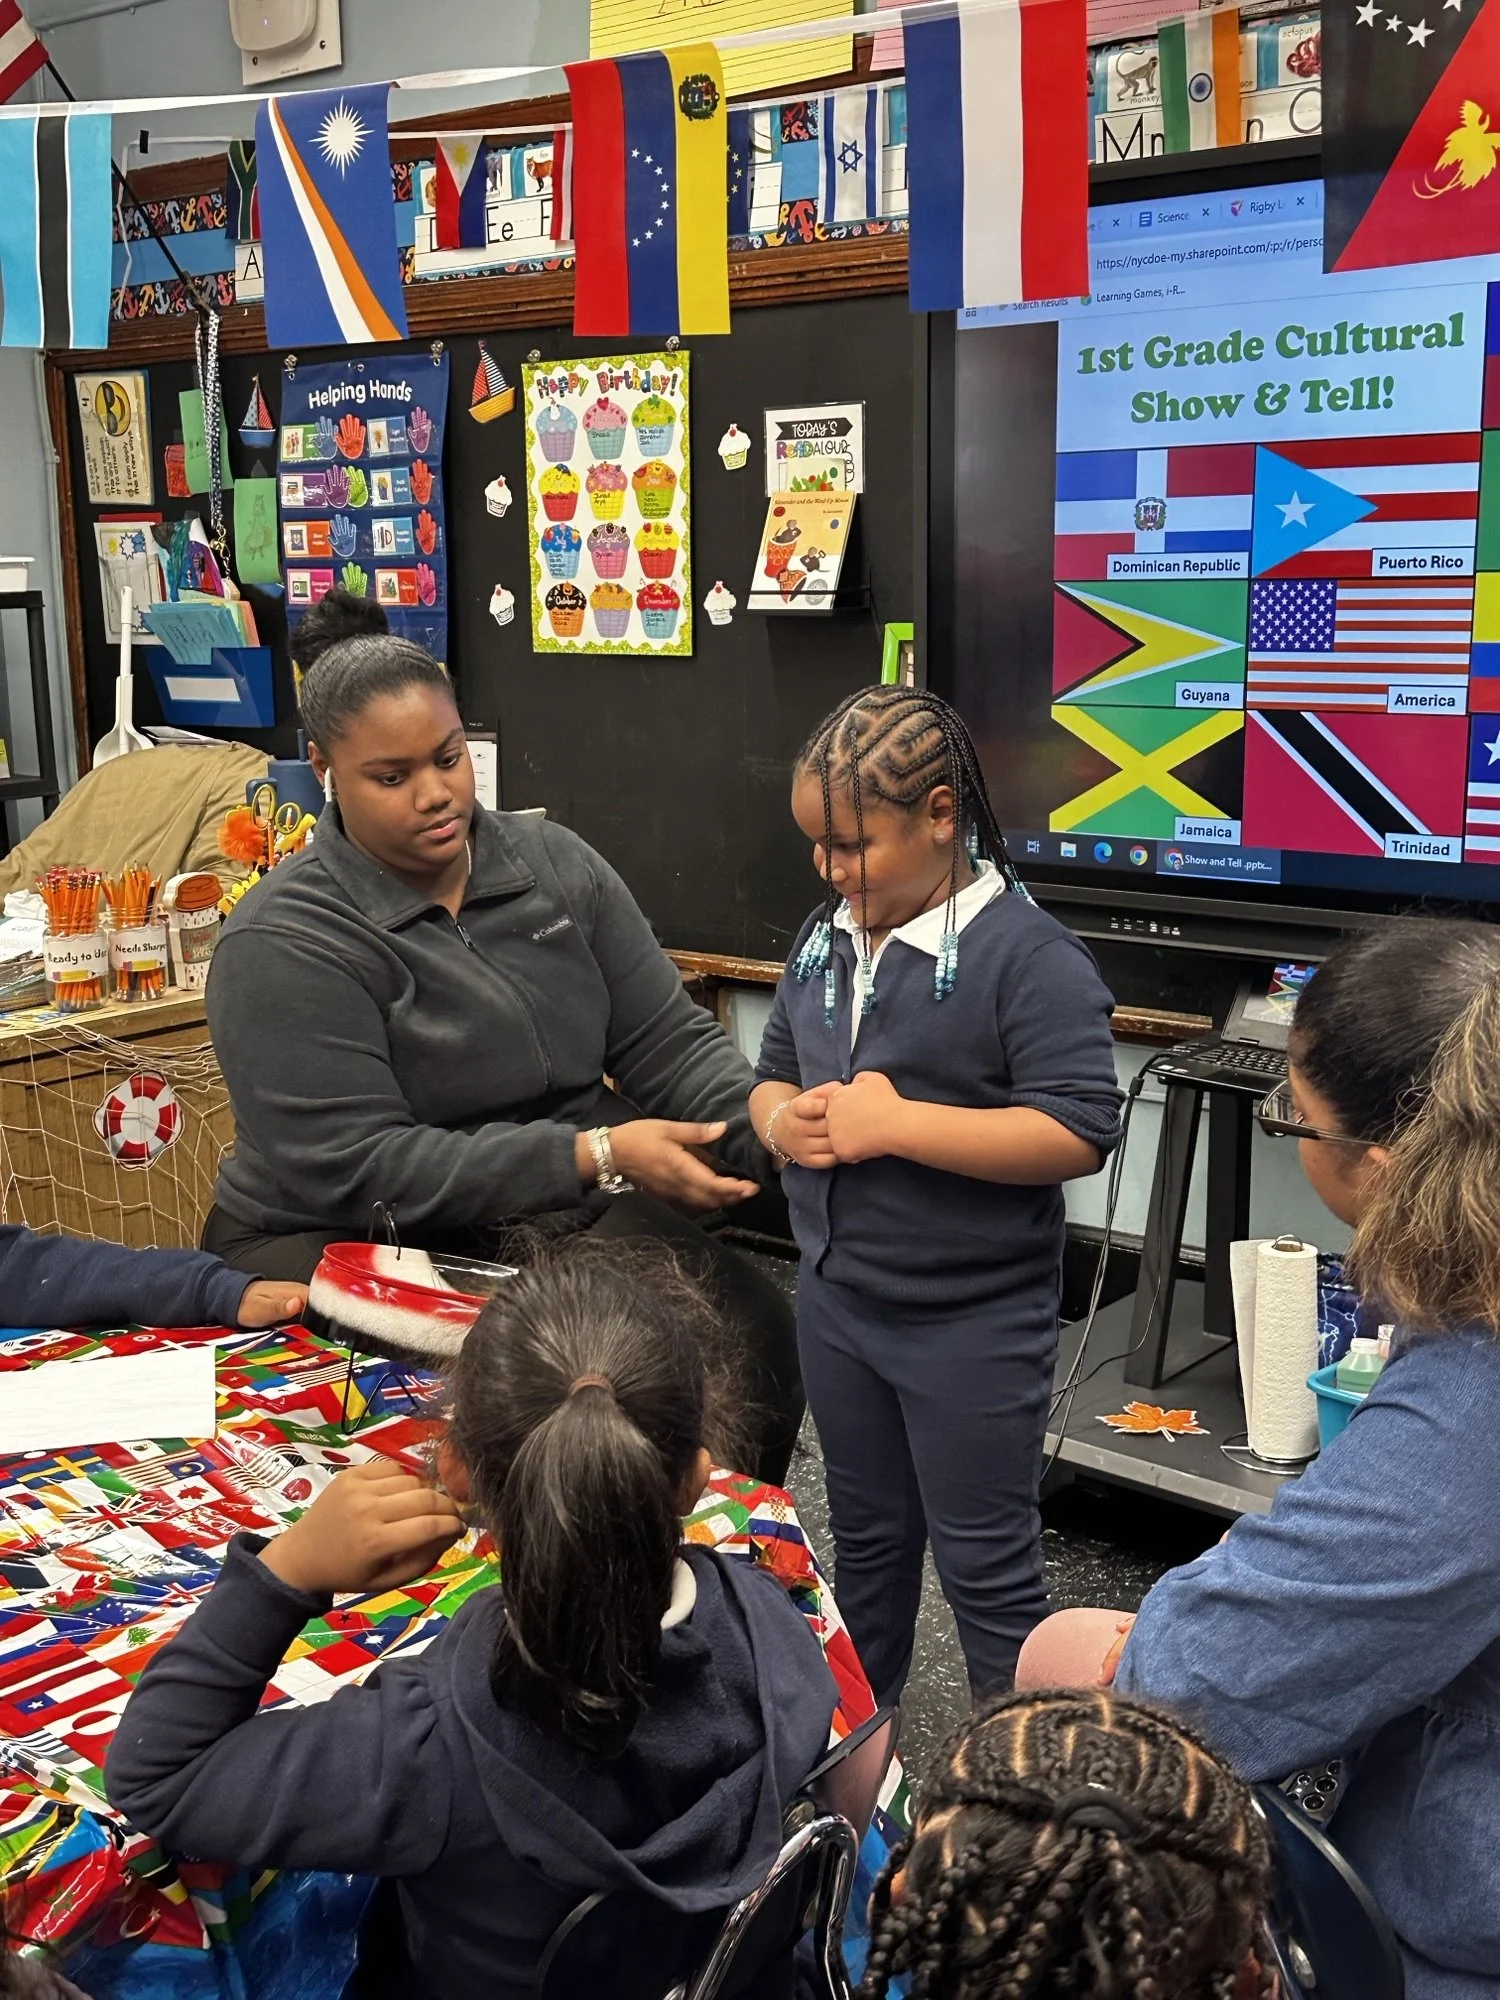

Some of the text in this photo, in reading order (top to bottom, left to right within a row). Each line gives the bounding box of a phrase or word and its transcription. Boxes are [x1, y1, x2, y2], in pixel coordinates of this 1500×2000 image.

[1130, 94, 1160, 105] monkey
[1250, 201, 1276, 214] Rigby
[1096, 291, 1132, 303] Learning
[1134, 288, 1164, 299] Games,
[1077, 311, 1465, 375] 1st Grade Cultural
[536, 367, 678, 399] Happy Birthday!
[308, 379, 413, 409] Helping Hands
[1130, 375, 1395, 425] Show & Tell!
[792, 421, 838, 438] TODAY'S
[1113, 558, 1241, 574] Dominican Republic
[1378, 555, 1464, 569] Puerto Rico
[1181, 688, 1230, 705] Guyana
[1394, 693, 1456, 707] America
[1180, 823, 1232, 838] Jamaica
[1391, 840, 1450, 856] Trinidad
[1185, 855, 1208, 866] Show
[1209, 857, 1226, 867] and
[1228, 857, 1242, 868] Tell
[115, 943, 141, 953] Needs
[81, 953, 92, 961] to
